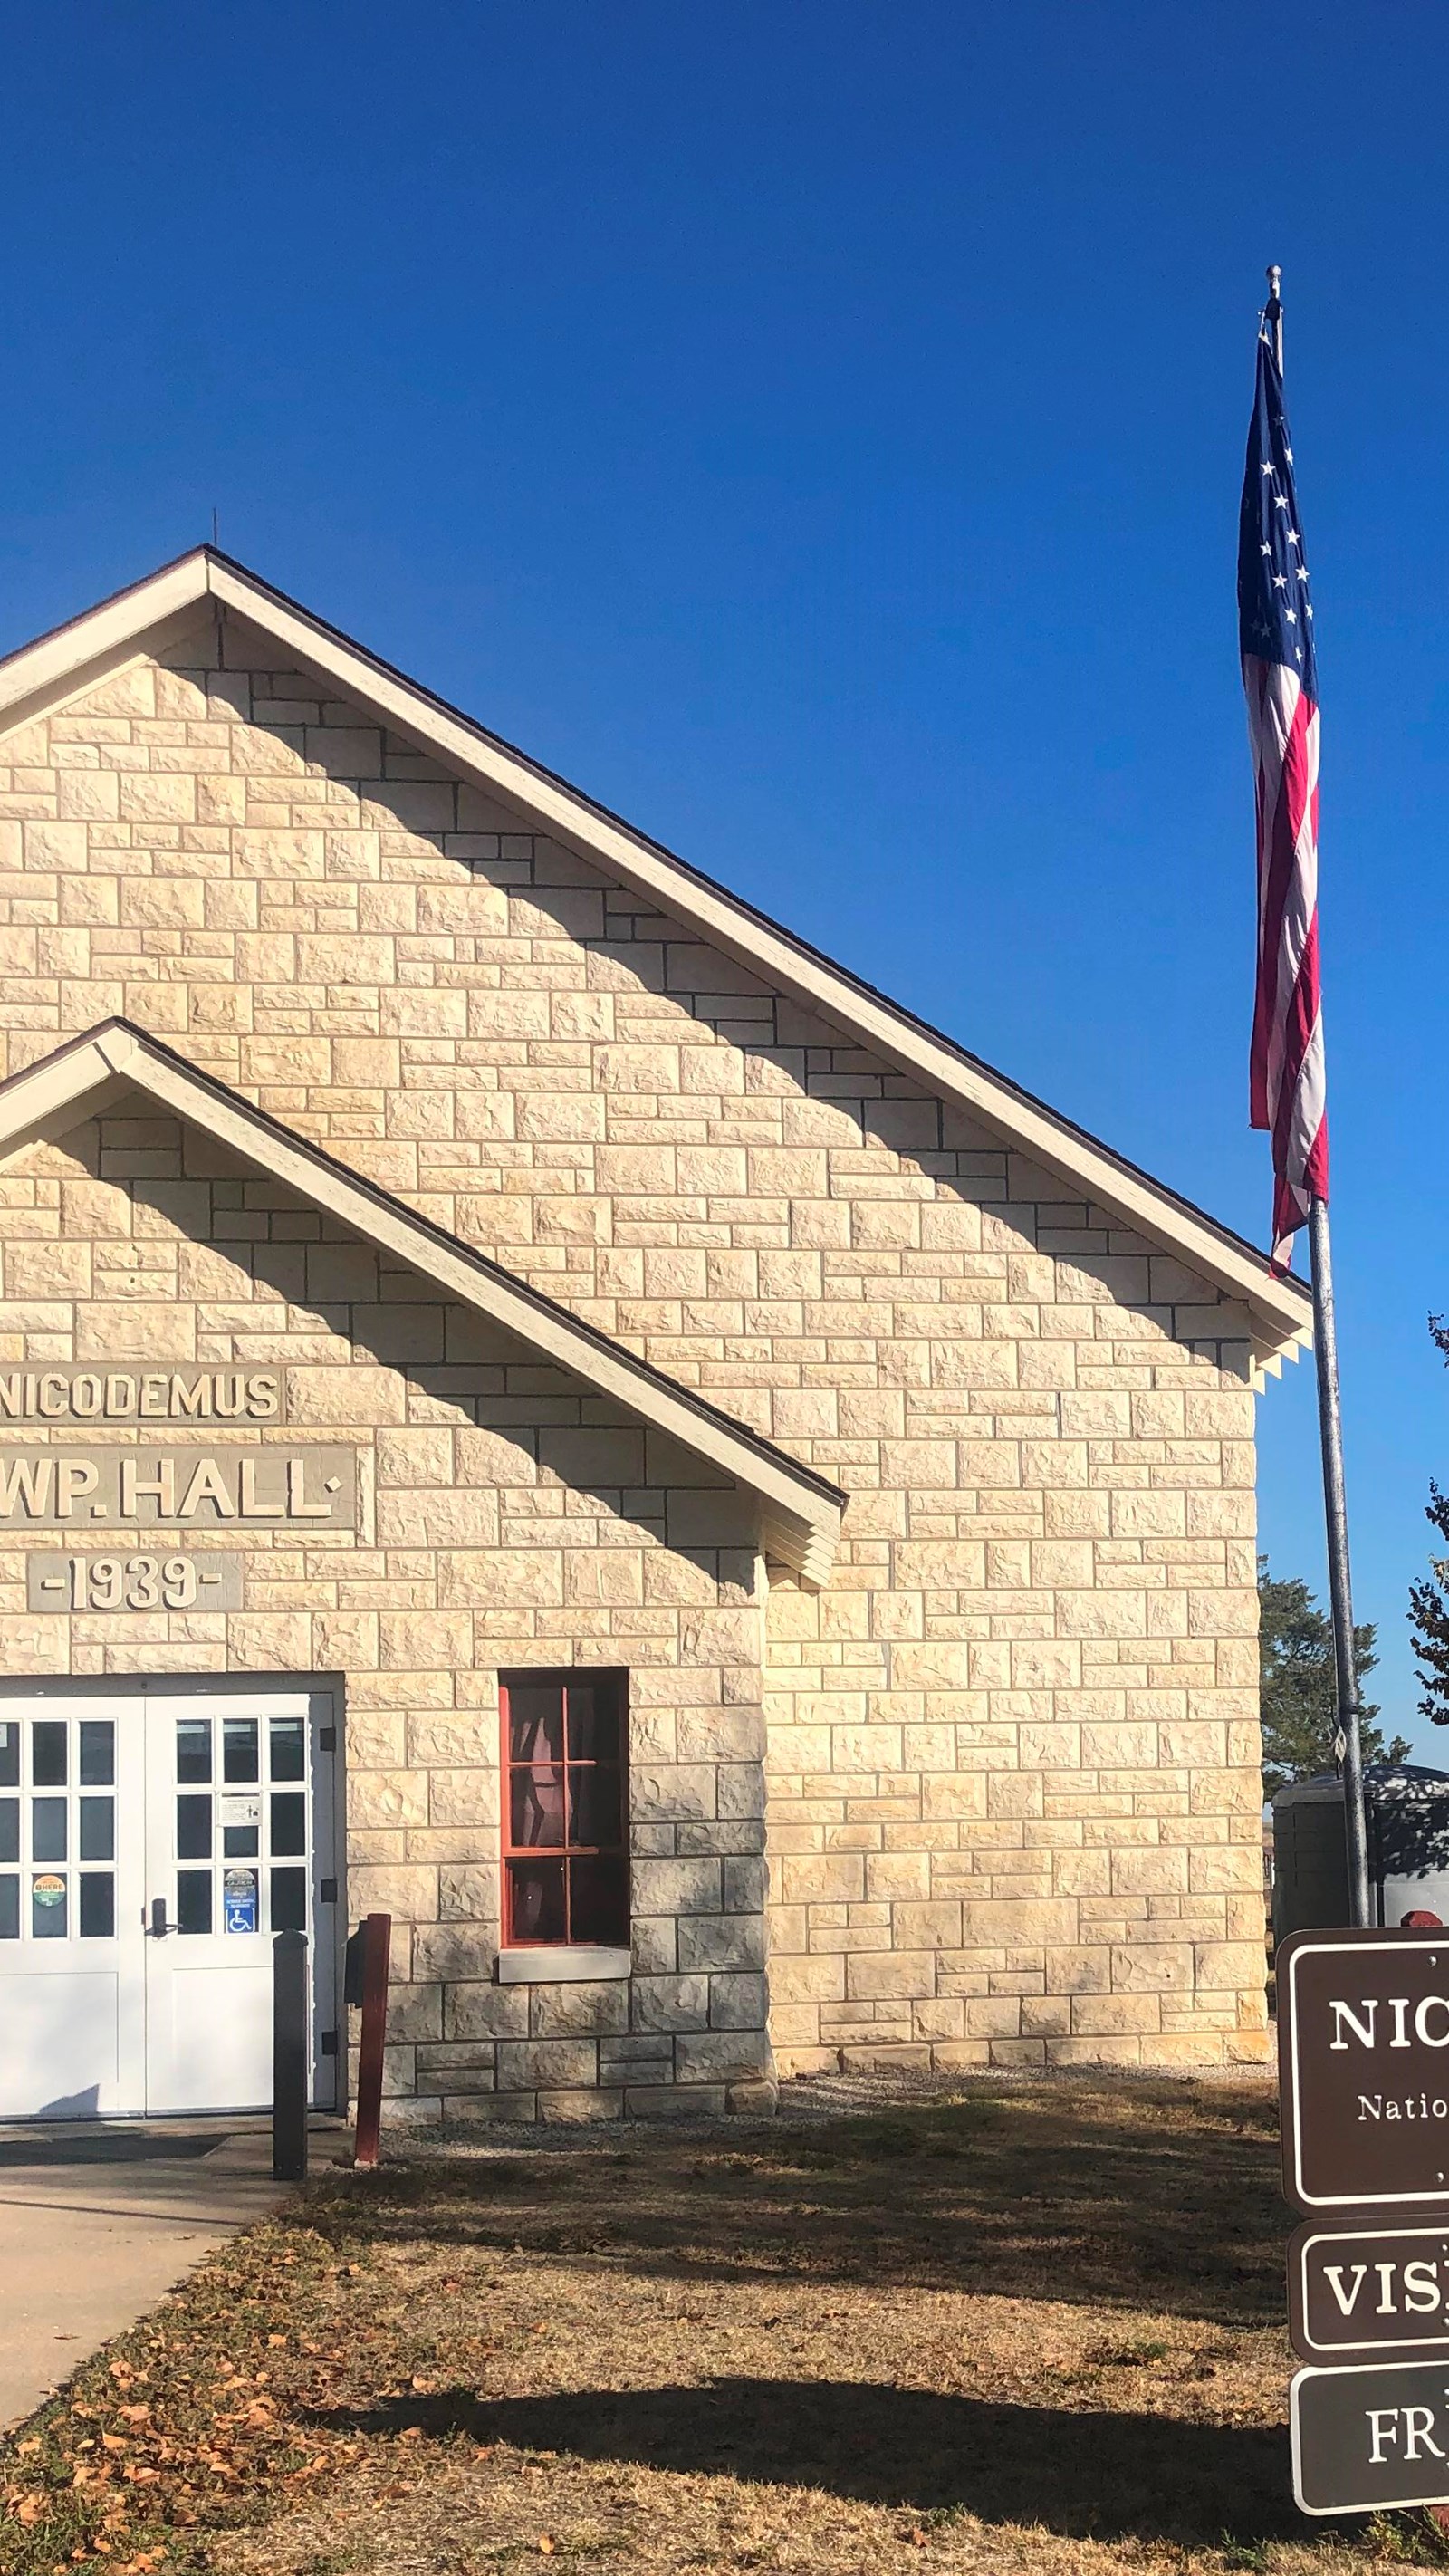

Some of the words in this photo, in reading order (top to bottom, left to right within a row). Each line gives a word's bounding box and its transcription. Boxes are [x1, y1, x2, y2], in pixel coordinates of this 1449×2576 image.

[0, 1372, 279, 1418] NICODEMUS
[1358, 2093, 1449, 2121] Natio
[1323, 2261, 1449, 2316] VIS
[1365, 2405, 1449, 2464] FR
